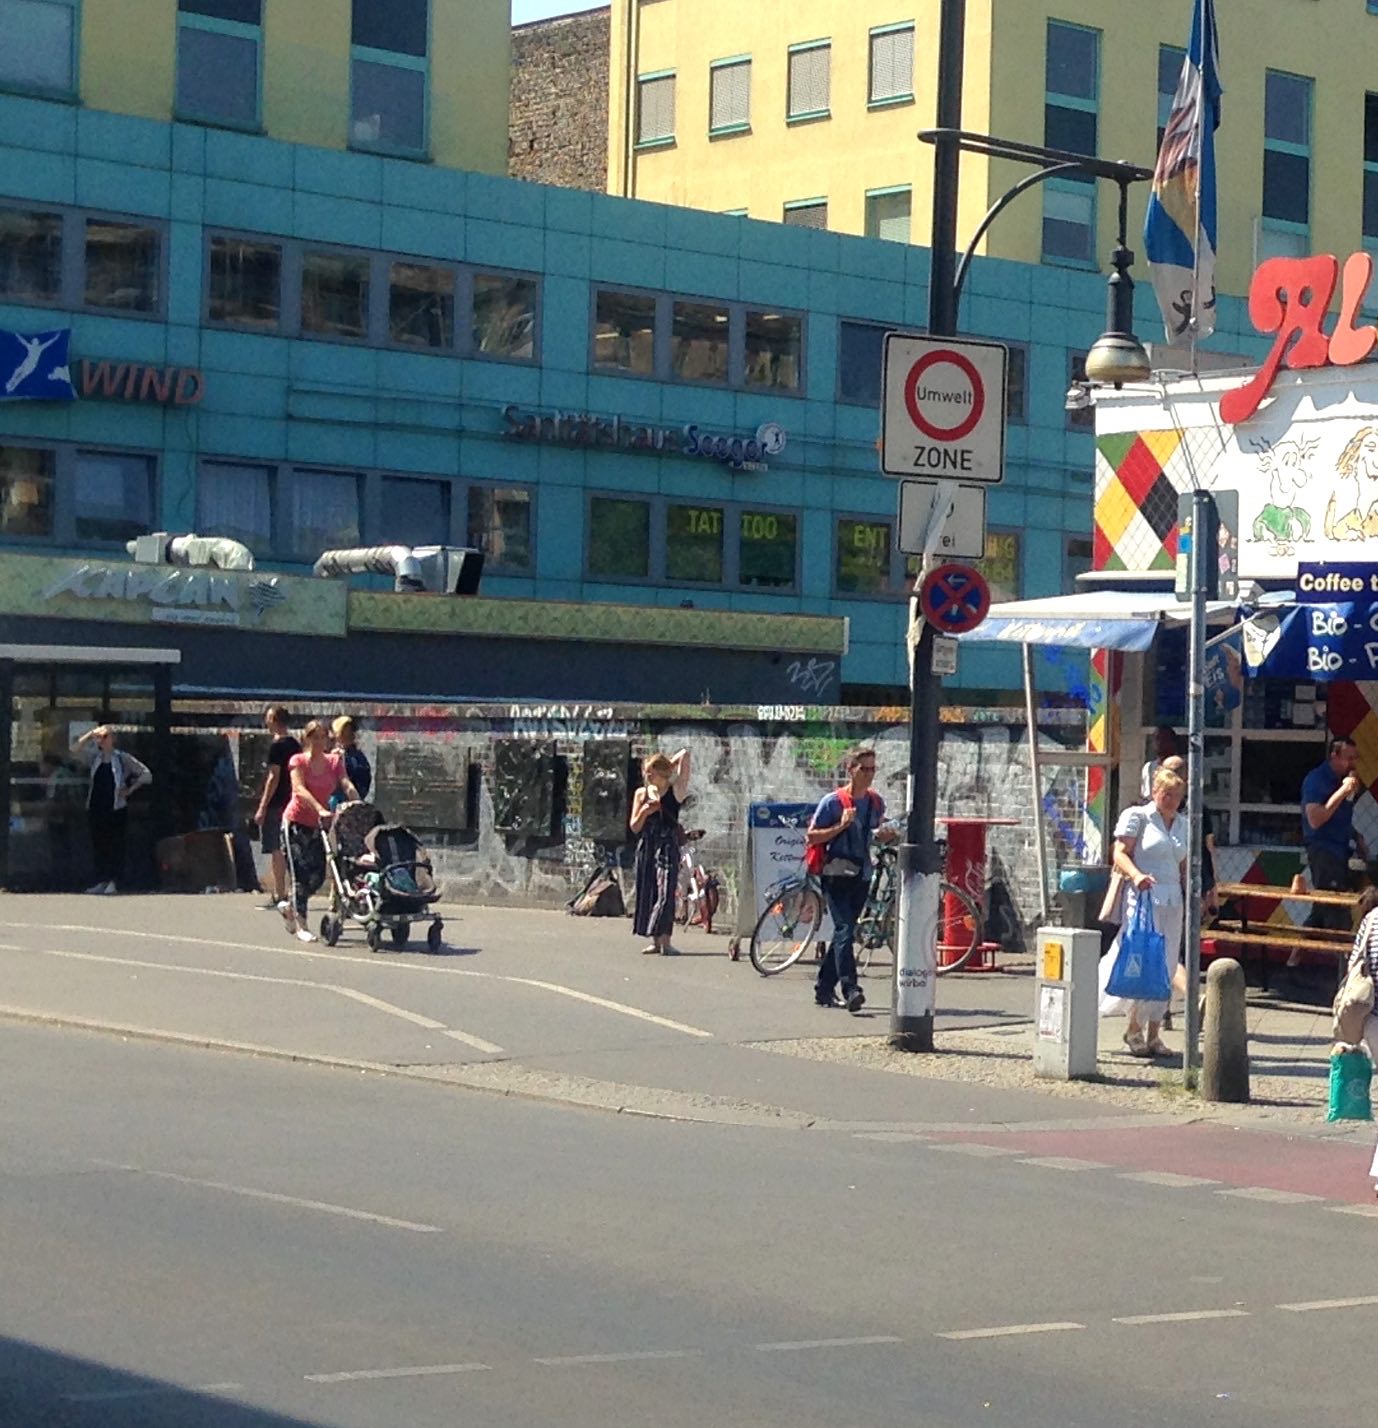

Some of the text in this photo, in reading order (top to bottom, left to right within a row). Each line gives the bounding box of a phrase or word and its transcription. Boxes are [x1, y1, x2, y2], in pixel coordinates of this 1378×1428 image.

[81, 358, 204, 405] WIND
[917, 386, 972, 405] Umwelt
[913, 446, 973, 471] ZONE
[1299, 573, 1364, 592] Coffee
[1312, 611, 1347, 636] Bio
[1307, 645, 1343, 672] Bio
